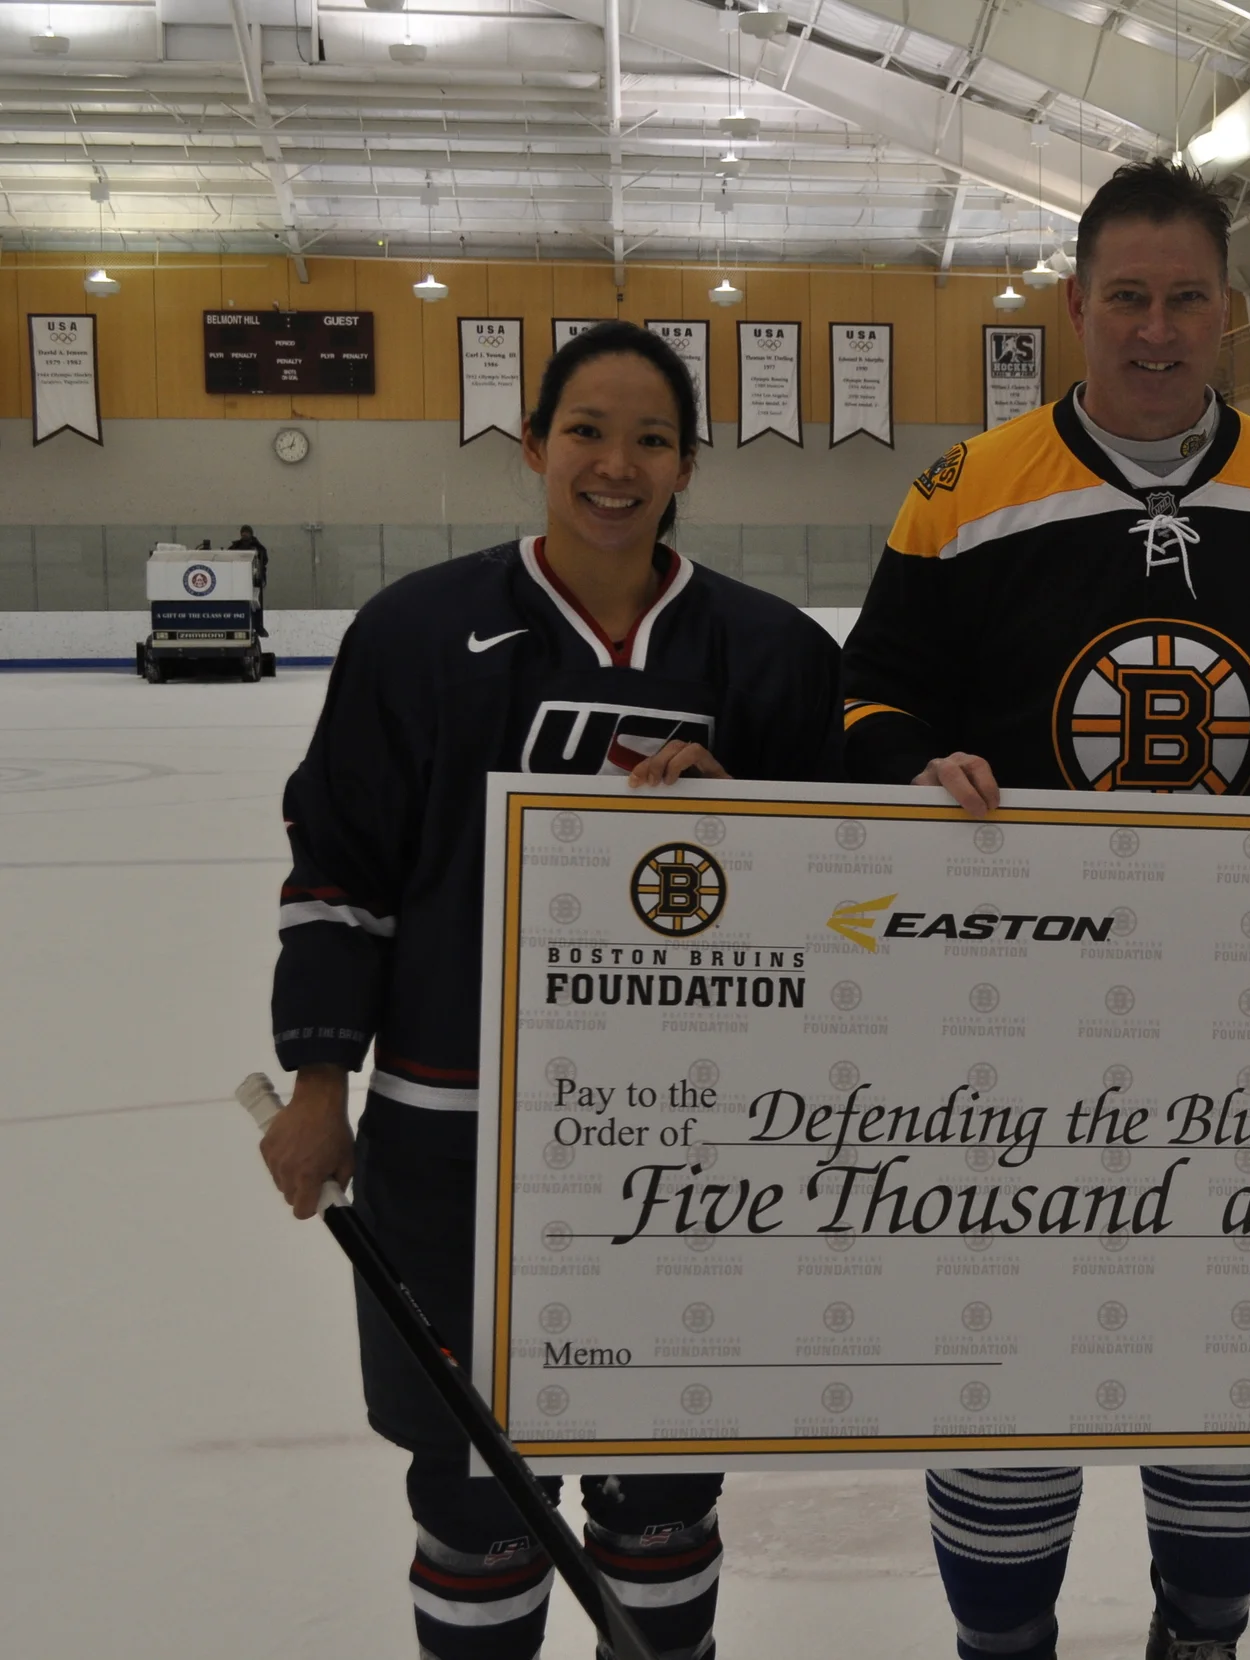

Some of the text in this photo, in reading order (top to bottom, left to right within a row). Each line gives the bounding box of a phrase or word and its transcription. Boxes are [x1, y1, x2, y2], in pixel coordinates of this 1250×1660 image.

[48, 322, 77, 330] USA
[206, 315, 260, 325] BELMONT HILL
[324, 316, 359, 326] GUEST
[476, 325, 505, 334] USA
[662, 328, 692, 337] USA
[754, 329, 784, 338] USA
[846, 331, 876, 339] USA
[807, 861, 892, 876] FOUNDATION
[946, 865, 1029, 879] FOUNDATION
[1082, 868, 1164, 882] FOUNDATION
[884, 912, 1114, 942] EASTON
[548, 947, 804, 968] BOSTON BRUINS
[943, 944, 1028, 959] FOUNDATION
[1080, 947, 1162, 961] FOUNDATION
[546, 973, 805, 1008] FOUNDATION
[318, 1028, 336, 1038] THE
[661, 1019, 747, 1034] FOUNDATION
[802, 1021, 888, 1036] FOUNDATION
[941, 1024, 1024, 1038] FOUNDATION
[1078, 1026, 1160, 1040] FOUNDATION
[554, 1078, 716, 1115] Pay to the
[554, 1117, 649, 1146] Order
[660, 1118, 697, 1146] of
[748, 1083, 1048, 1167] Defending
[1067, 1086, 1149, 1145] the
[611, 1162, 784, 1245] Five
[807, 1156, 1190, 1235] Thousand
[656, 1263, 742, 1278] FOUNDATION
[797, 1263, 882, 1278] FOUNDATION
[936, 1263, 1019, 1277] FOUNDATION
[1072, 1263, 1154, 1277] FOUNDATION
[544, 1342, 632, 1365] Memo
[654, 1344, 740, 1359] FOUNDATION
[795, 1343, 880, 1358] FOUNDATION
[934, 1342, 1017, 1356] FOUNDATION
[1070, 1342, 1153, 1356] FOUNDATION
